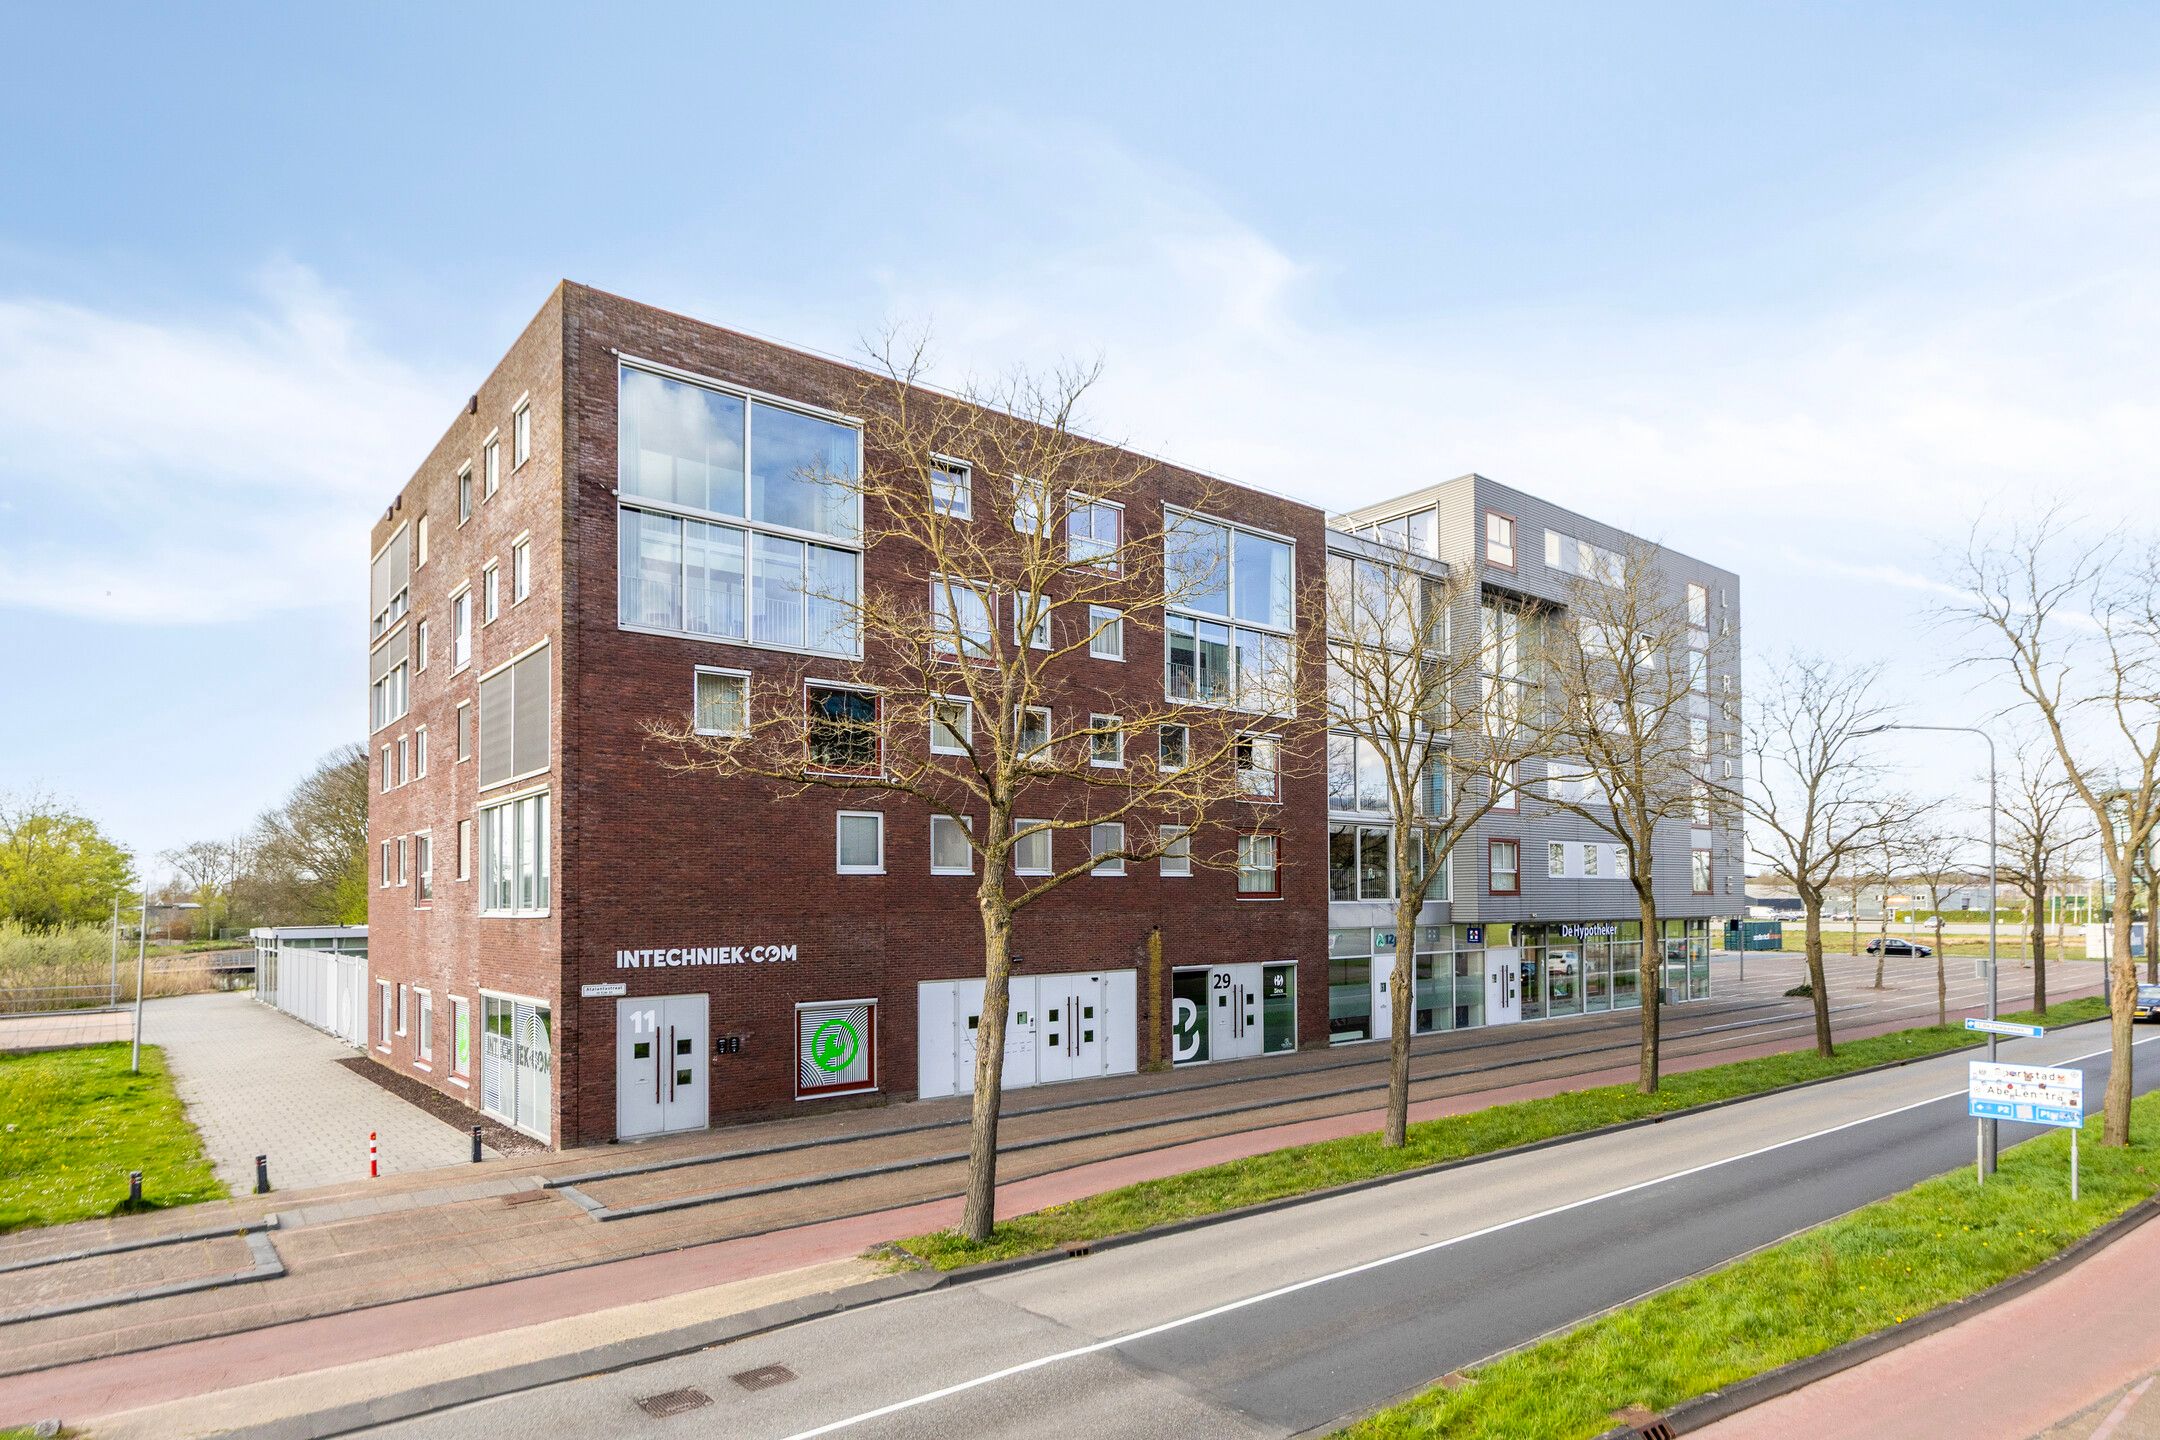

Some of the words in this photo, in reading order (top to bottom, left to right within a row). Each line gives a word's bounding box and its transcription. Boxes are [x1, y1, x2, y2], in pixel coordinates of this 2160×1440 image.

[1562, 925, 1573, 937] De
[1573, 923, 1617, 939] Hypotheker
[1213, 973, 1231, 989] 29
[629, 1010, 656, 1034] 11
[2015, 1088, 2063, 1102] Lentra
